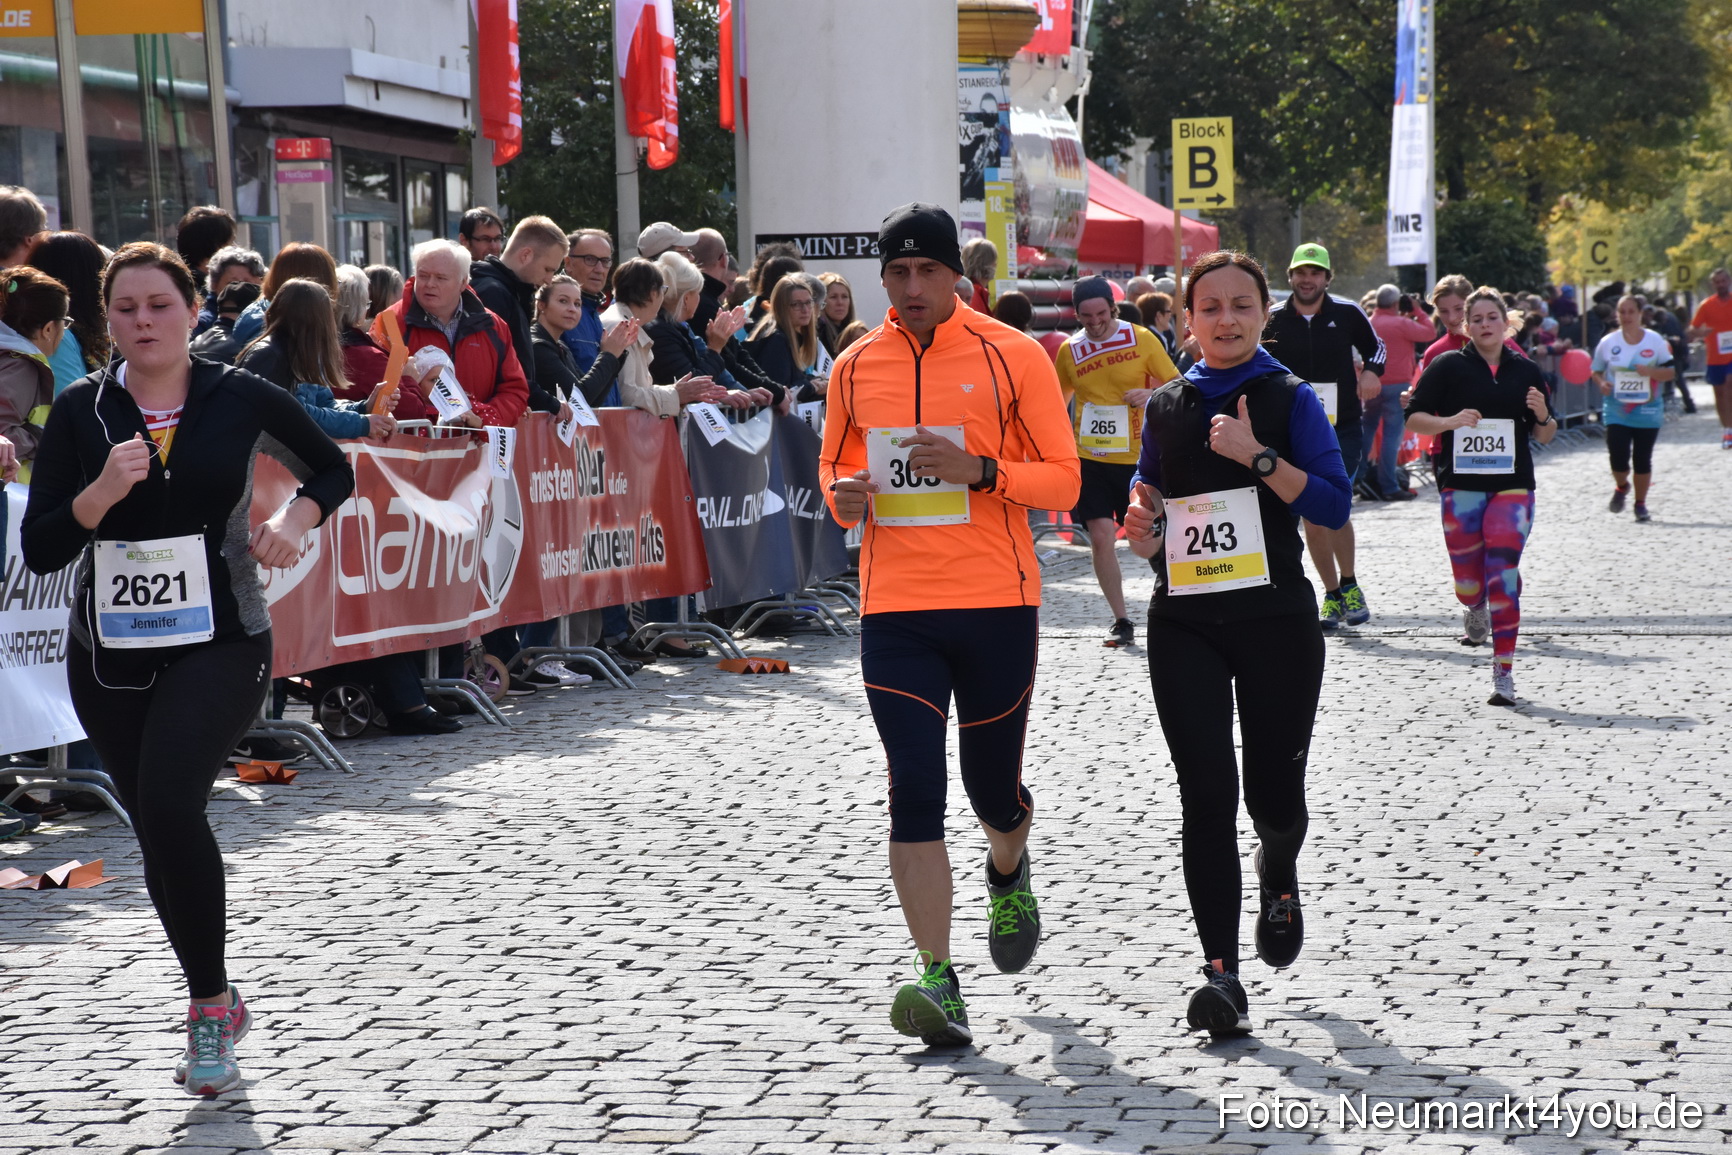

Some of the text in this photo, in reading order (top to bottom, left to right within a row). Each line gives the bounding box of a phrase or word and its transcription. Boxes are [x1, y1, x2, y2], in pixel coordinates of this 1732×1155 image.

[1179, 121, 1226, 139] Block
[296, 139, 311, 158] T
[1188, 145, 1218, 189] B
[1591, 240, 1609, 265] C
[1677, 265, 1691, 283] D
[1075, 350, 1141, 379] MAX BÖGL
[1620, 381, 1644, 392] 2221
[1090, 420, 1117, 435] 265
[1462, 436, 1506, 453] 2034
[1185, 522, 1238, 556] 243
[1195, 563, 1234, 577] Babette
[111, 570, 188, 607] 2621
[130, 616, 178, 630] Jennifer
